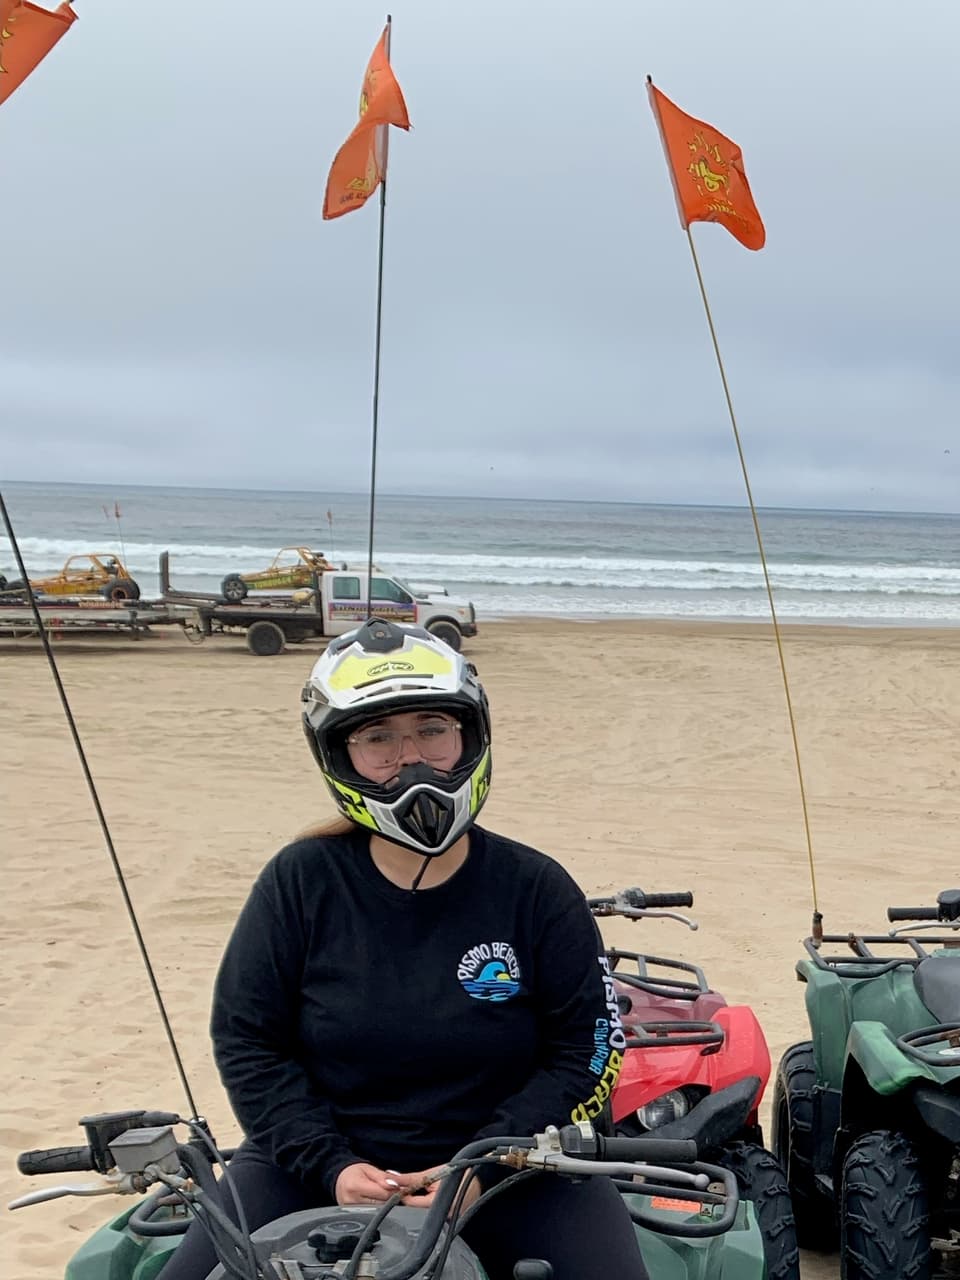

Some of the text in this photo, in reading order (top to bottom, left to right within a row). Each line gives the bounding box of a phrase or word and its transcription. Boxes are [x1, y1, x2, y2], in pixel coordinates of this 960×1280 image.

[457, 942, 521, 981] PISMO BEACH
[597, 956, 627, 1049] PISMO
